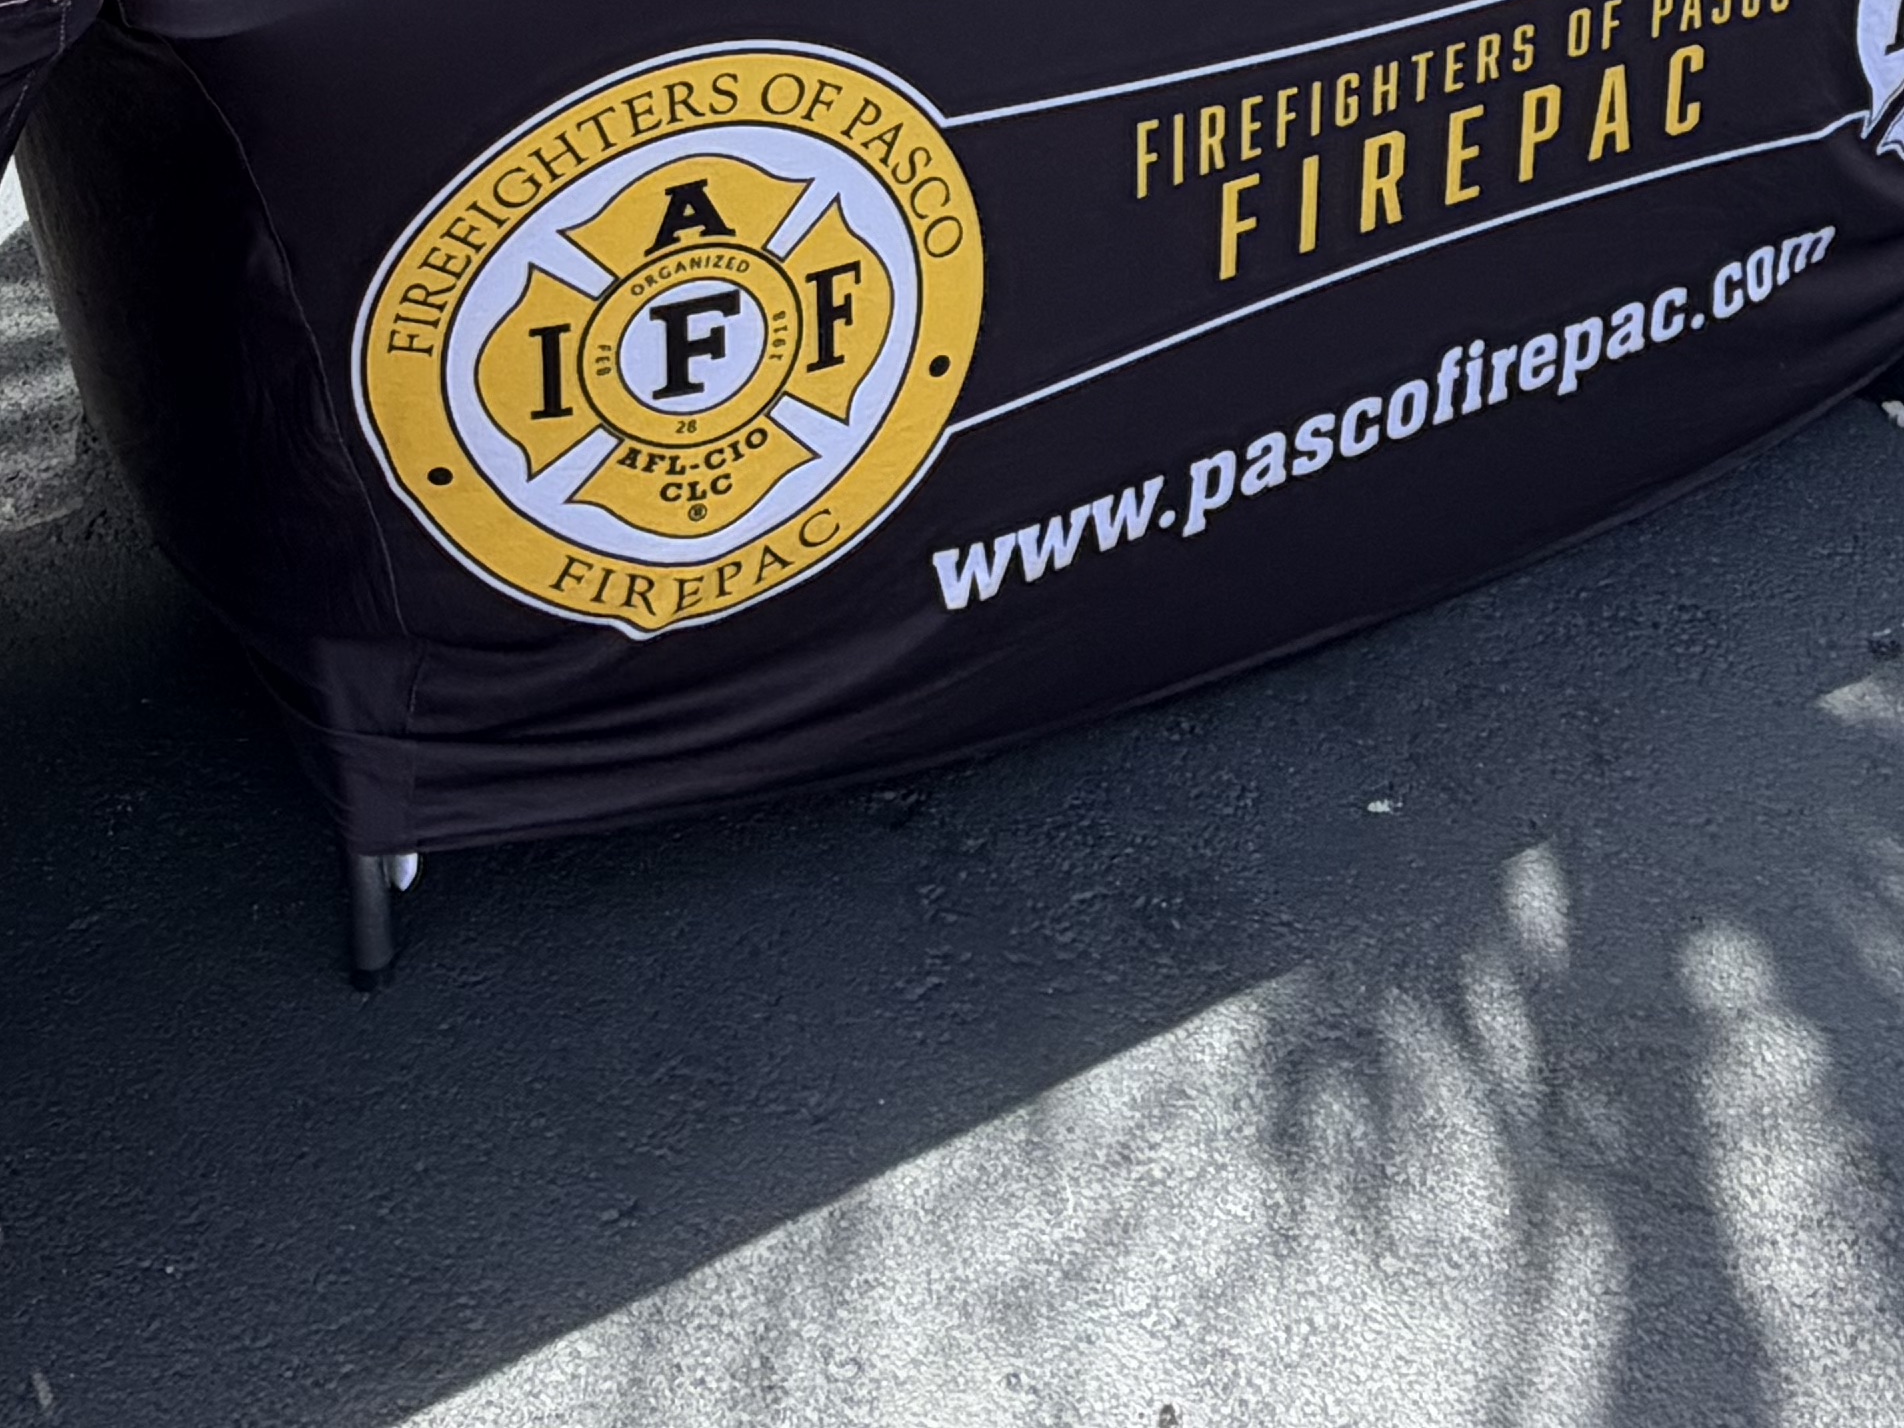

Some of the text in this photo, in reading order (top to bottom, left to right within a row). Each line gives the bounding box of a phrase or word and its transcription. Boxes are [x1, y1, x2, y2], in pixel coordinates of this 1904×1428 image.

[1134, 22, 1536, 200] FIREFIGHTERS
[1217, 43, 1707, 281] FIREPAC
[388, 71, 965, 360] FIREFIGHTERS OF PASCO
[630, 254, 751, 298] ORGANIZED
[644, 178, 737, 257] A
[648, 289, 742, 401] F
[805, 260, 862, 374] F
[617, 427, 770, 476] AFL-CIO
[932, 224, 1836, 611] www.pascofirepac.com
[659, 473, 734, 502] CLC
[548, 508, 842, 618] FIREPAC
